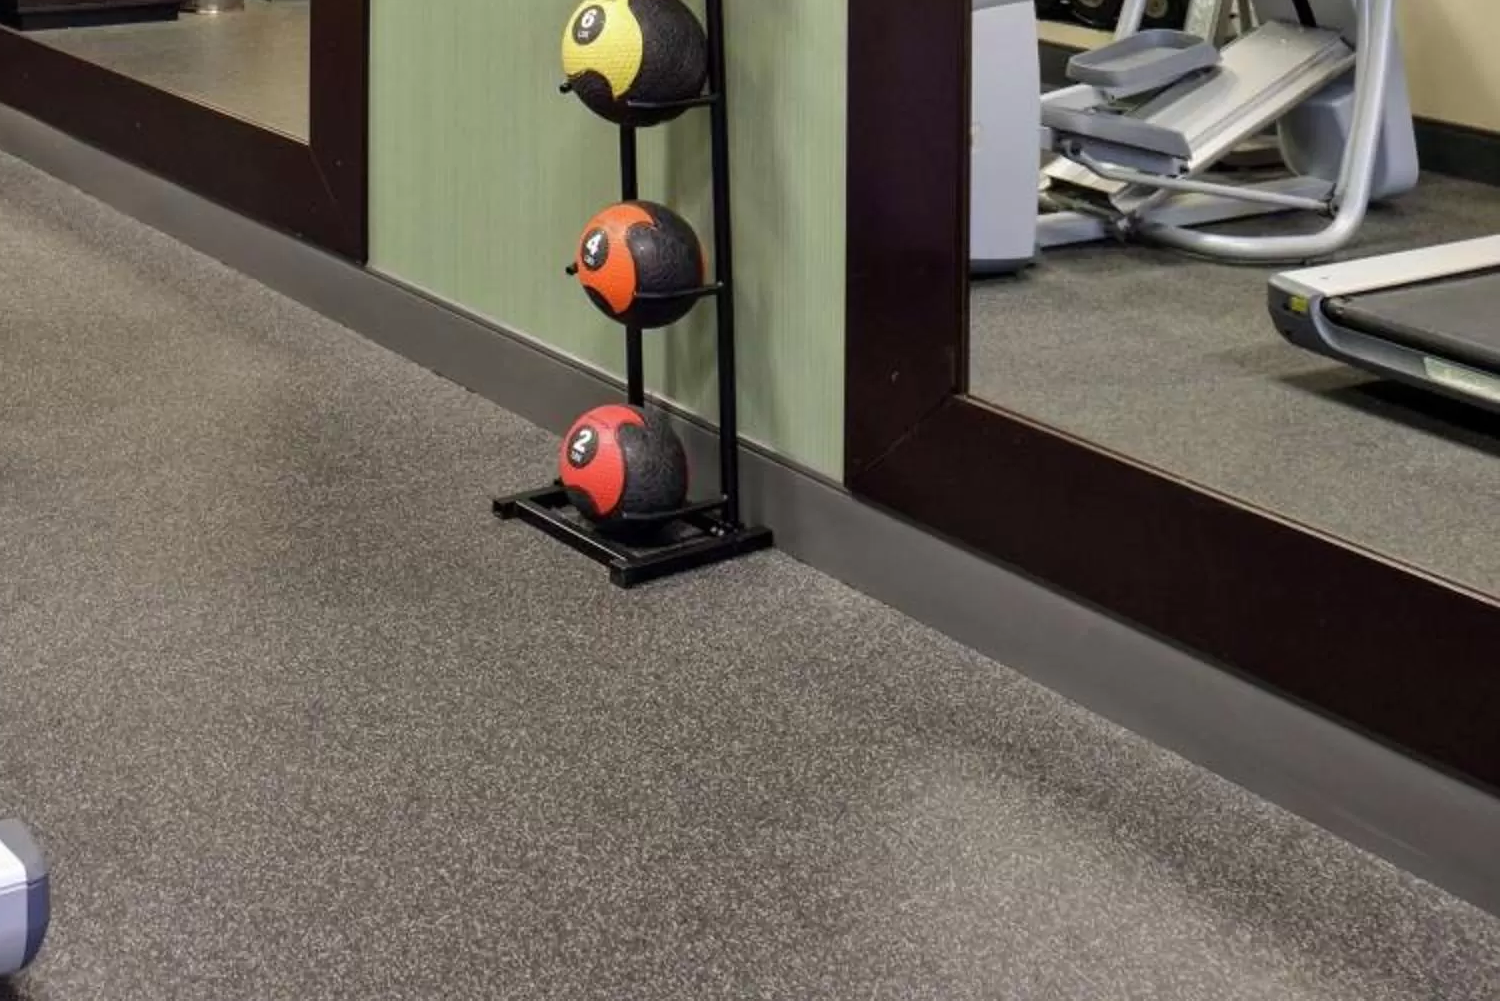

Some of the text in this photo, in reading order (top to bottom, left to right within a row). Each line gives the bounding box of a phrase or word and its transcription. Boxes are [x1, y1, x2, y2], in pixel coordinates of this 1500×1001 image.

[581, 8, 598, 29] 6
[585, 230, 602, 255] 4
[573, 429, 593, 453] 2
